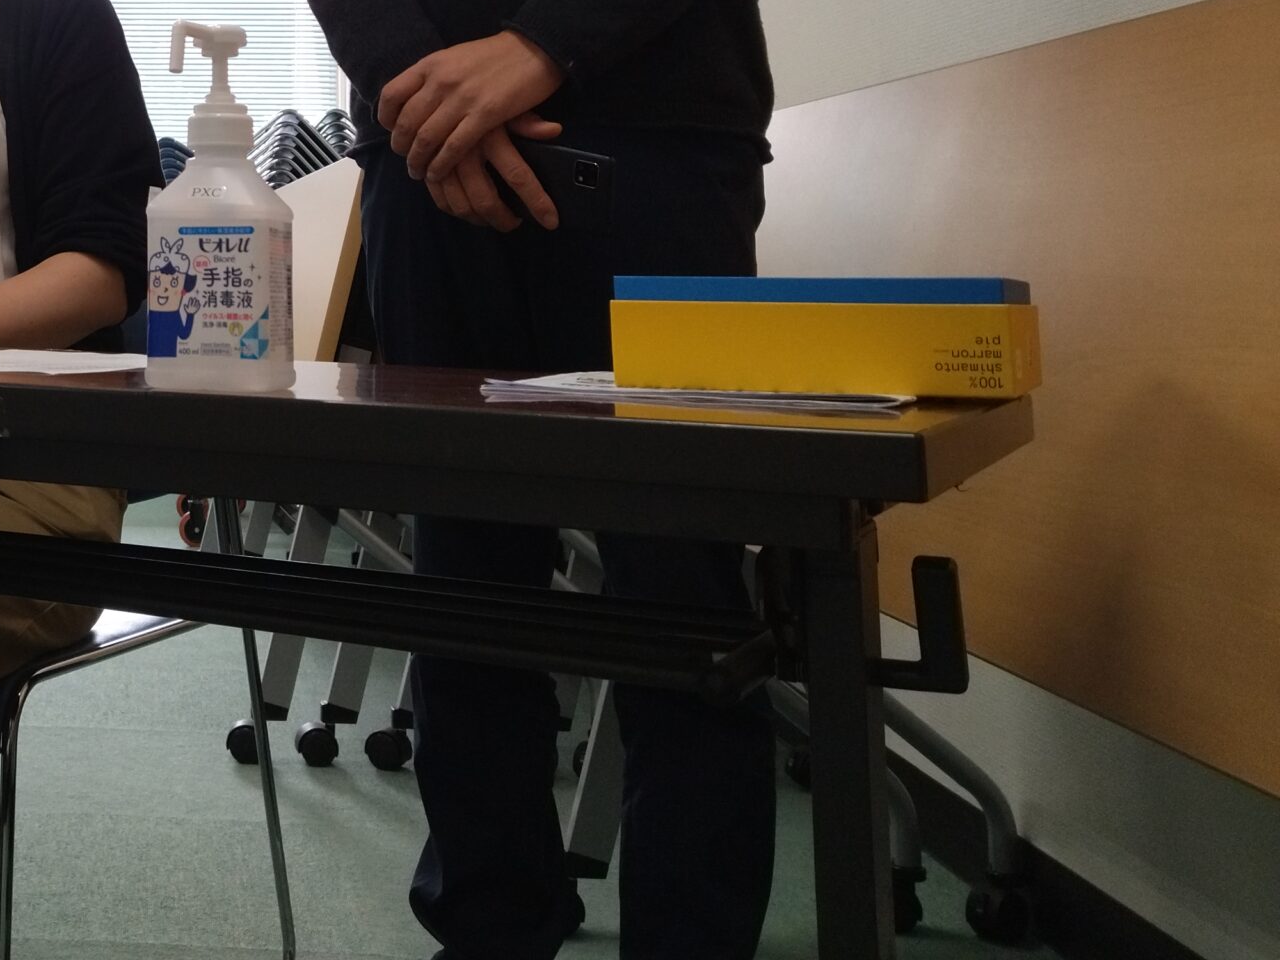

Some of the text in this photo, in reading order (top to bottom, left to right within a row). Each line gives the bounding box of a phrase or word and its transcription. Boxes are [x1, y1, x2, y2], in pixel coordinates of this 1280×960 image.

[191, 187, 222, 198] PXC
[202, 267, 254, 288] 手指の
[202, 290, 254, 309] 消毒液
[975, 335, 1001, 347] pie
[951, 349, 1003, 360] marron
[935, 362, 1003, 375] shimanto
[968, 376, 1004, 390] 100%
